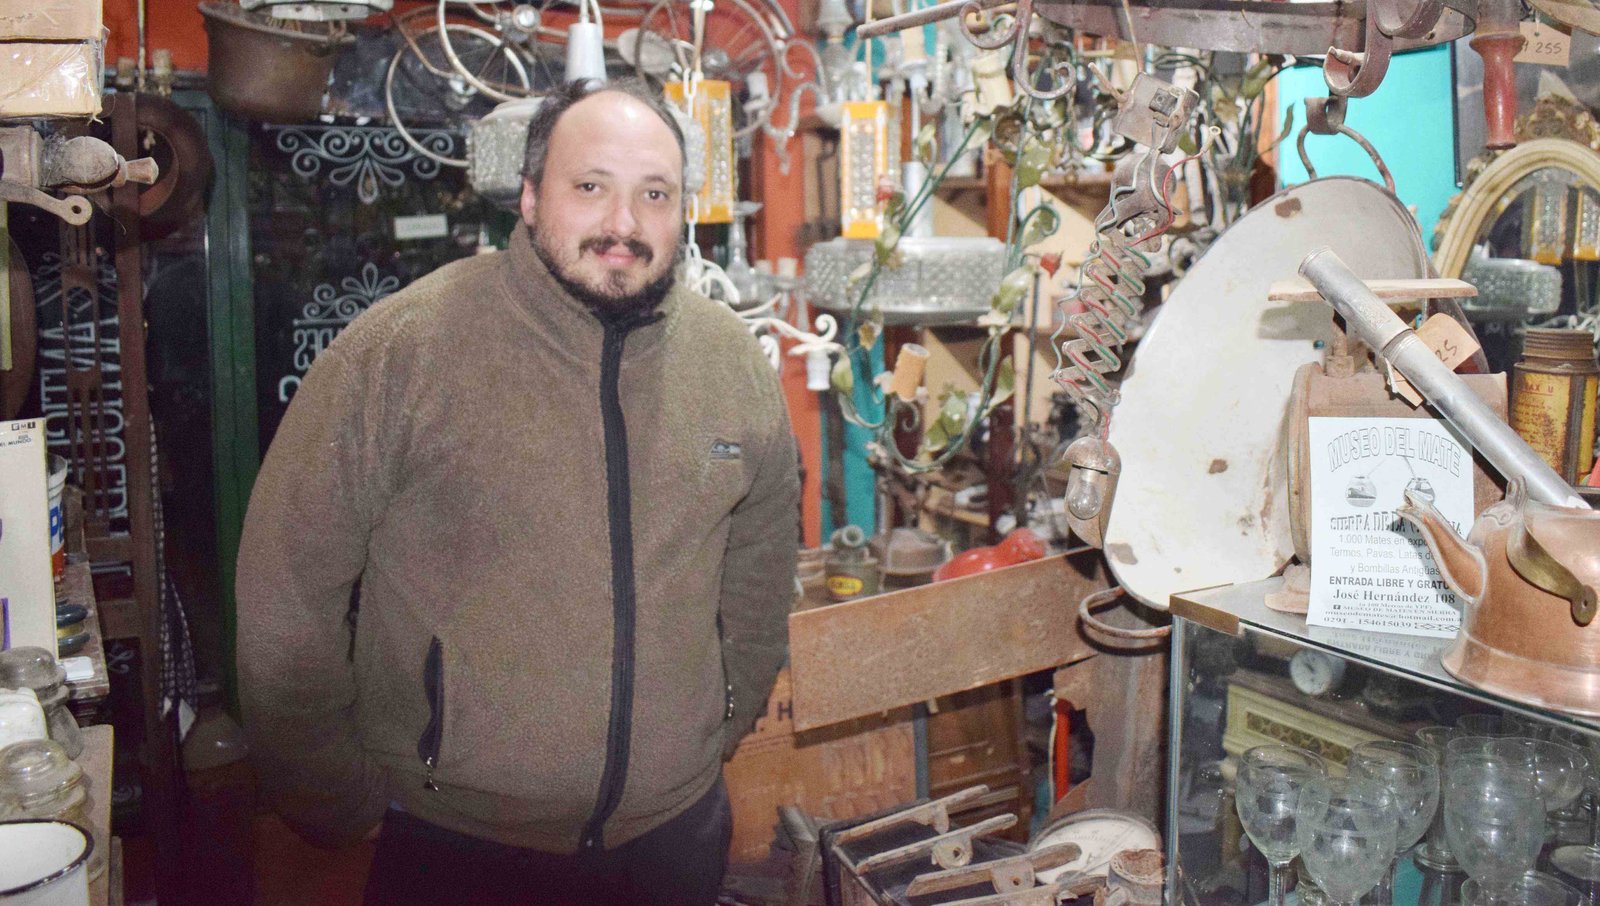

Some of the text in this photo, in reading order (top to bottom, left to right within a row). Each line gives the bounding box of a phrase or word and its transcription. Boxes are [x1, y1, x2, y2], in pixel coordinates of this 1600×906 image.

[1327, 426, 1381, 472] MUSEO
[1384, 426, 1415, 458] DEL
[1418, 430, 1462, 478] MATE
[1339, 534, 1363, 544] 1.000
[1365, 534, 1392, 545] Mates
[1393, 537, 1405, 545] en
[1398, 548, 1422, 560] Latas
[1350, 565, 1355, 574] y
[1357, 562, 1400, 574] Bombillas
[1329, 576, 1450, 590] ENTRADA LIBRE Y GRATU
[1332, 588, 1456, 604] José Hernández 108
[1323, 616, 1346, 624] 0291
[1358, 618, 1412, 628] 154615039
